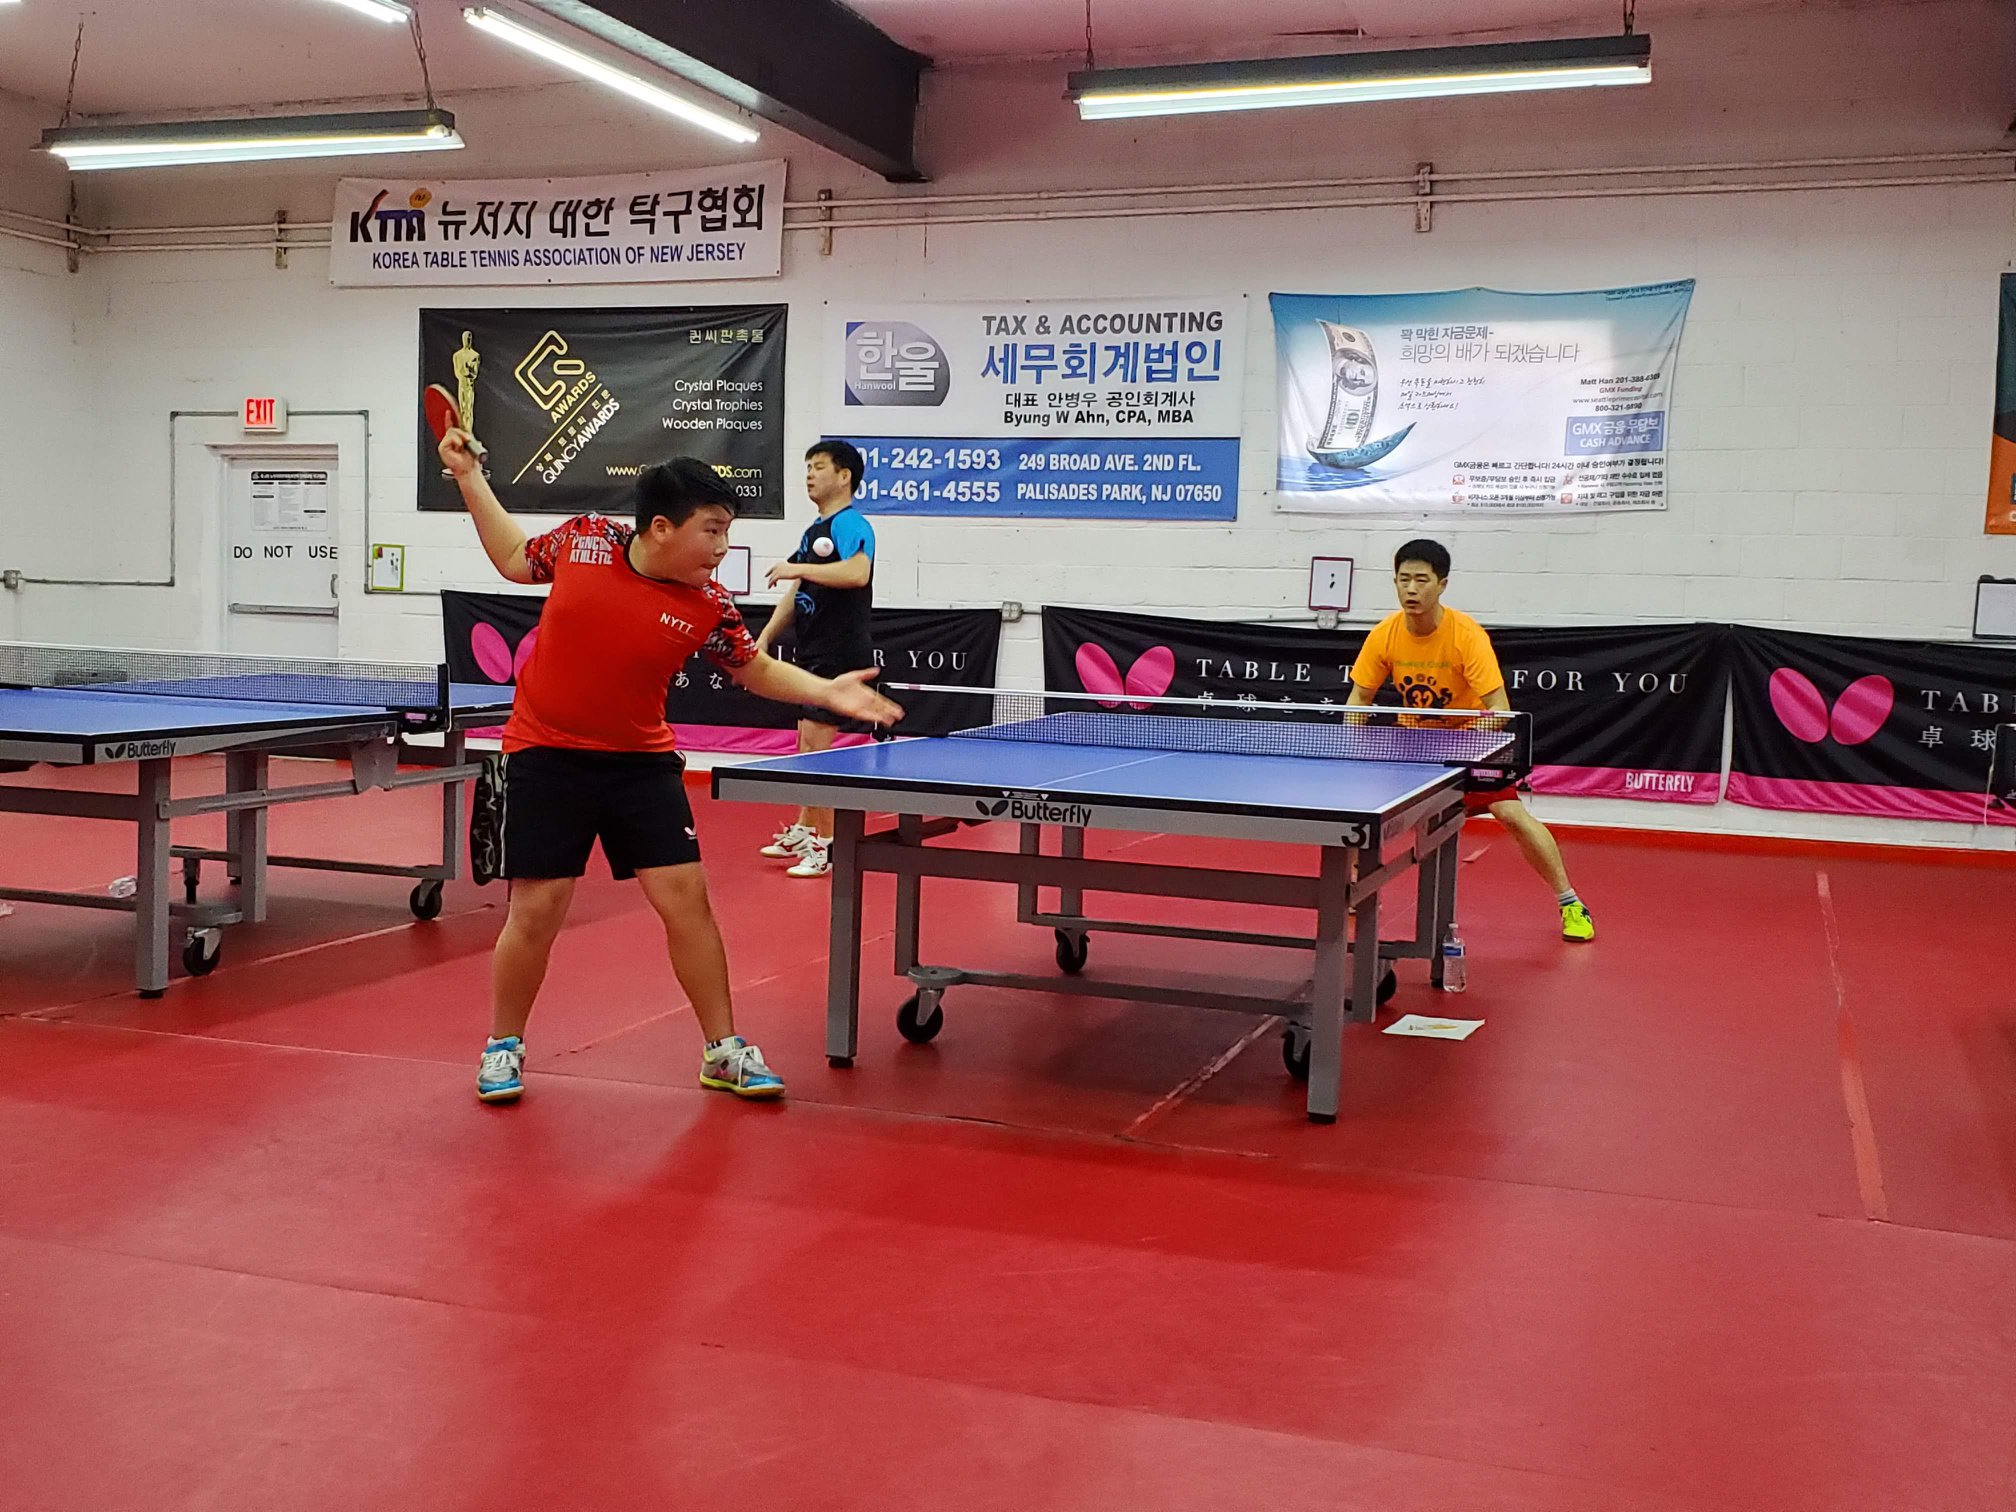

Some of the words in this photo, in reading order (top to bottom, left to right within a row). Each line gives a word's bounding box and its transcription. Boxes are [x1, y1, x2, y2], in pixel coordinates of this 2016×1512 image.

[437, 200, 538, 241] 뉴저지
[549, 197, 616, 239] 대한
[628, 183, 765, 235] 탁구협회
[372, 251, 420, 270] KOREA
[423, 251, 467, 269] TABLE
[470, 248, 520, 268] TENNIS
[523, 246, 621, 267] ASSOCIATION
[625, 246, 645, 265] OF
[649, 244, 683, 264] NEW
[686, 242, 746, 262] JERSEY
[982, 315, 1027, 336] TAX
[1035, 315, 1051, 335] &
[1059, 311, 1223, 335] ACCOUNTING
[856, 331, 940, 391] 한울
[981, 340, 1222, 385] 세무회계법인
[1400, 344, 1452, 364] 희망의
[1455, 343, 1490, 364] 배가
[1494, 343, 1580, 364] 되겠습니다
[675, 380, 713, 394] Crystal
[716, 380, 763, 394] Plaques
[854, 380, 896, 391] Hanwool
[550, 371, 597, 424] AWARDS
[672, 399, 712, 413] Crystal
[715, 399, 763, 413] Trophies
[1005, 393, 1038, 409] 대표
[1047, 392, 1097, 408] 안병우
[1106, 390, 1195, 408] 공인회계사
[246, 398, 275, 425] EXIT
[1004, 411, 1050, 427] Byung
[1056, 411, 1069, 424] W
[1074, 411, 1110, 426] Ahn,
[1115, 411, 1152, 426] CPA,
[1157, 410, 1194, 424] MBA
[662, 417, 713, 430] Wooden
[716, 418, 763, 432] Plaques
[1572, 422, 1601, 435] GMX
[542, 397, 620, 485] QUINCYAWARDS
[1580, 437, 1605, 447] CASH
[1608, 434, 1651, 446] ADVANCE
[1018, 454, 1045, 471] 249
[1049, 454, 1100, 471] BROAD
[1104, 454, 1138, 471] AVE.
[1143, 454, 1173, 471] 2ND
[1178, 454, 1201, 471] FL.
[854, 479, 1000, 503] 01-461-4555
[1017, 484, 1098, 501] PALISADES
[1101, 484, 1146, 504] PARK,
[1151, 484, 1172, 502] NJ
[1175, 484, 1222, 502] 07650
[233, 546, 253, 559] DO
[264, 545, 294, 558] NOT
[308, 545, 338, 560] USE
[660, 611, 694, 634] NYTT
[908, 650, 967, 671] YOU
[1196, 658, 1311, 683] TABLE
[1511, 669, 1584, 692] FOR
[1612, 672, 1688, 695] YOU
[1921, 689, 2016, 715] TAB
[127, 740, 176, 758] Butterfly
[1625, 772, 1694, 793] BUTTERFLY
[1011, 800, 1092, 828] Butterfly
[1341, 823, 1367, 848] 3
